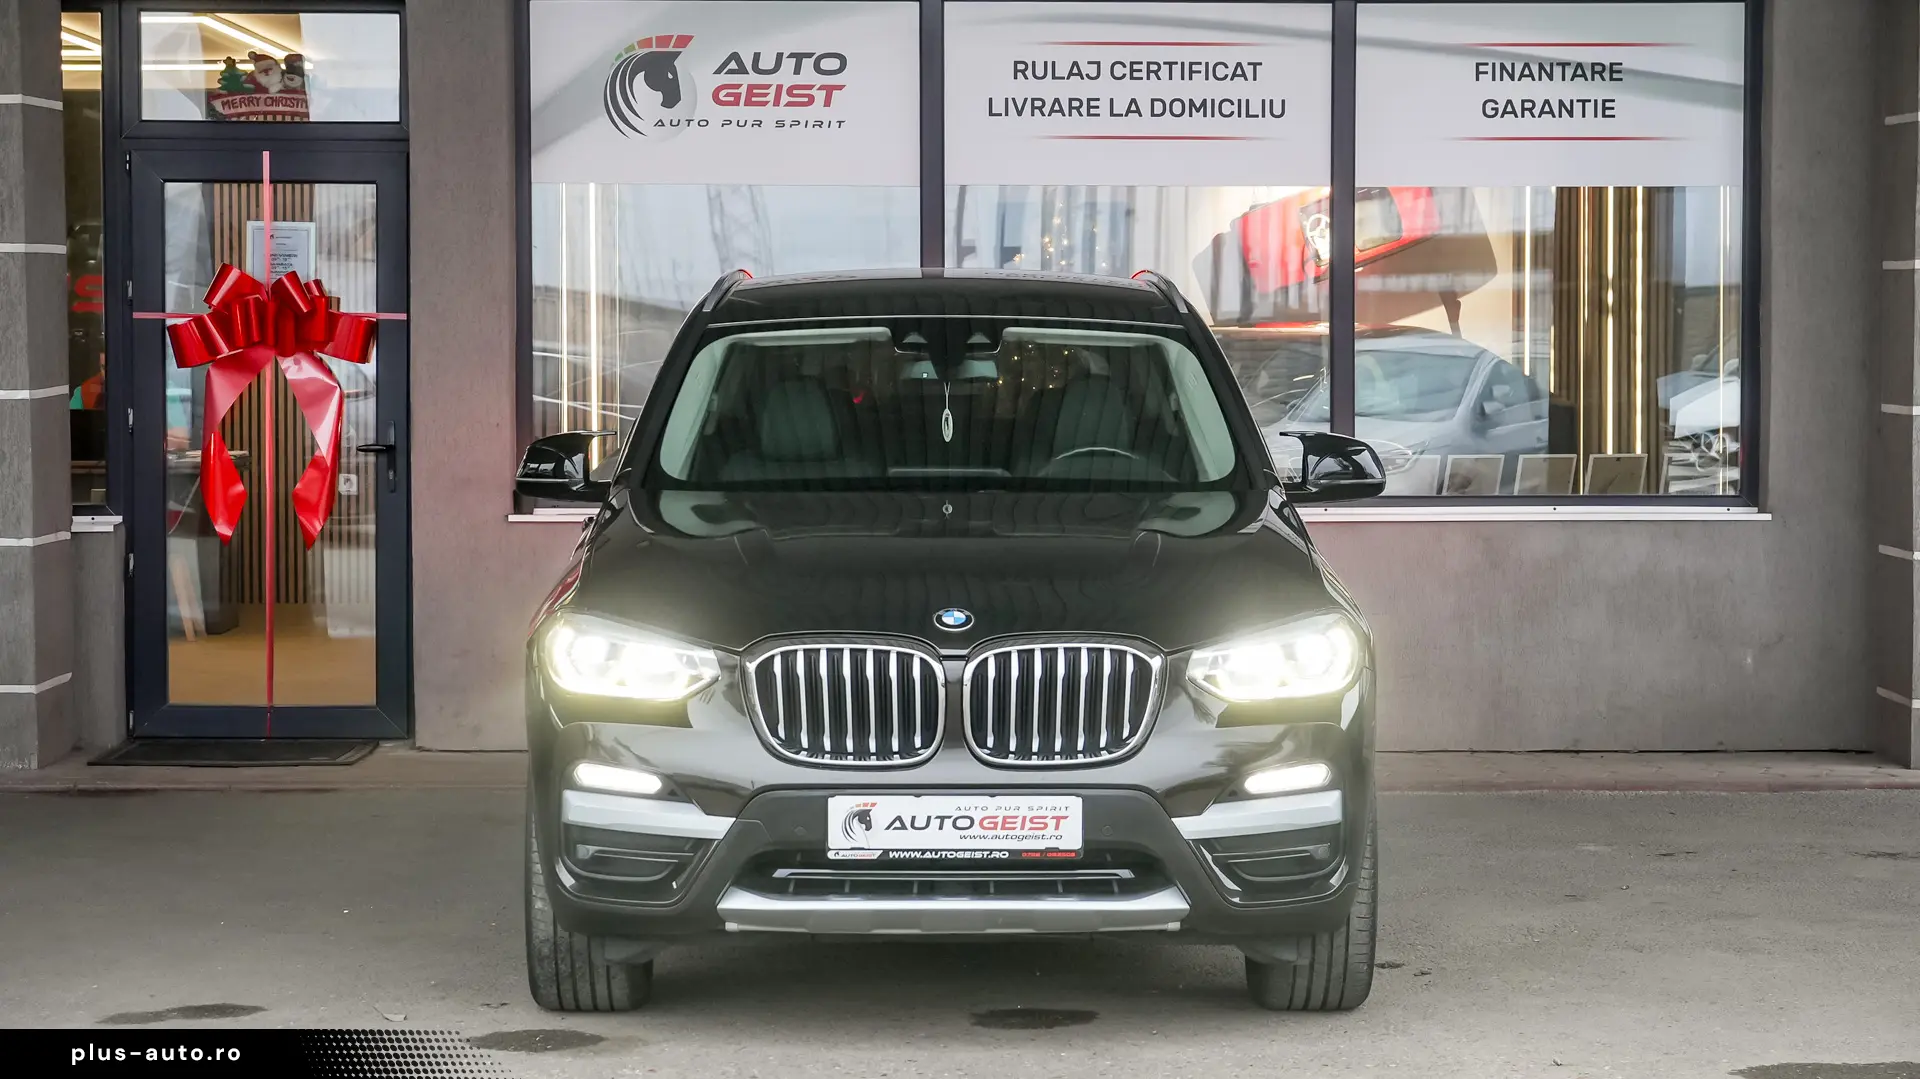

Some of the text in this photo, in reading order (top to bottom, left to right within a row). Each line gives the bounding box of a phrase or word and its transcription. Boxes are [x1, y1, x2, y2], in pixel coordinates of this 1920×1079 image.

[712, 51, 848, 76] AUTO
[1013, 60, 1263, 82] RULAJ CERTIFICAT
[1475, 61, 1624, 82] FINANTARE
[221, 96, 261, 111] MERRY
[711, 83, 847, 108] GEIST
[988, 97, 1287, 119] LIVRARE LA DOMICILIU
[1481, 98, 1616, 119] GARANTIE
[653, 118, 847, 129] AUTO PUR SPIRIT
[884, 815, 1070, 831] AUTOGEIST
[959, 833, 1063, 842] www.autogeist.ro
[888, 850, 1010, 859] WWW.AUTOGEIST.RO
